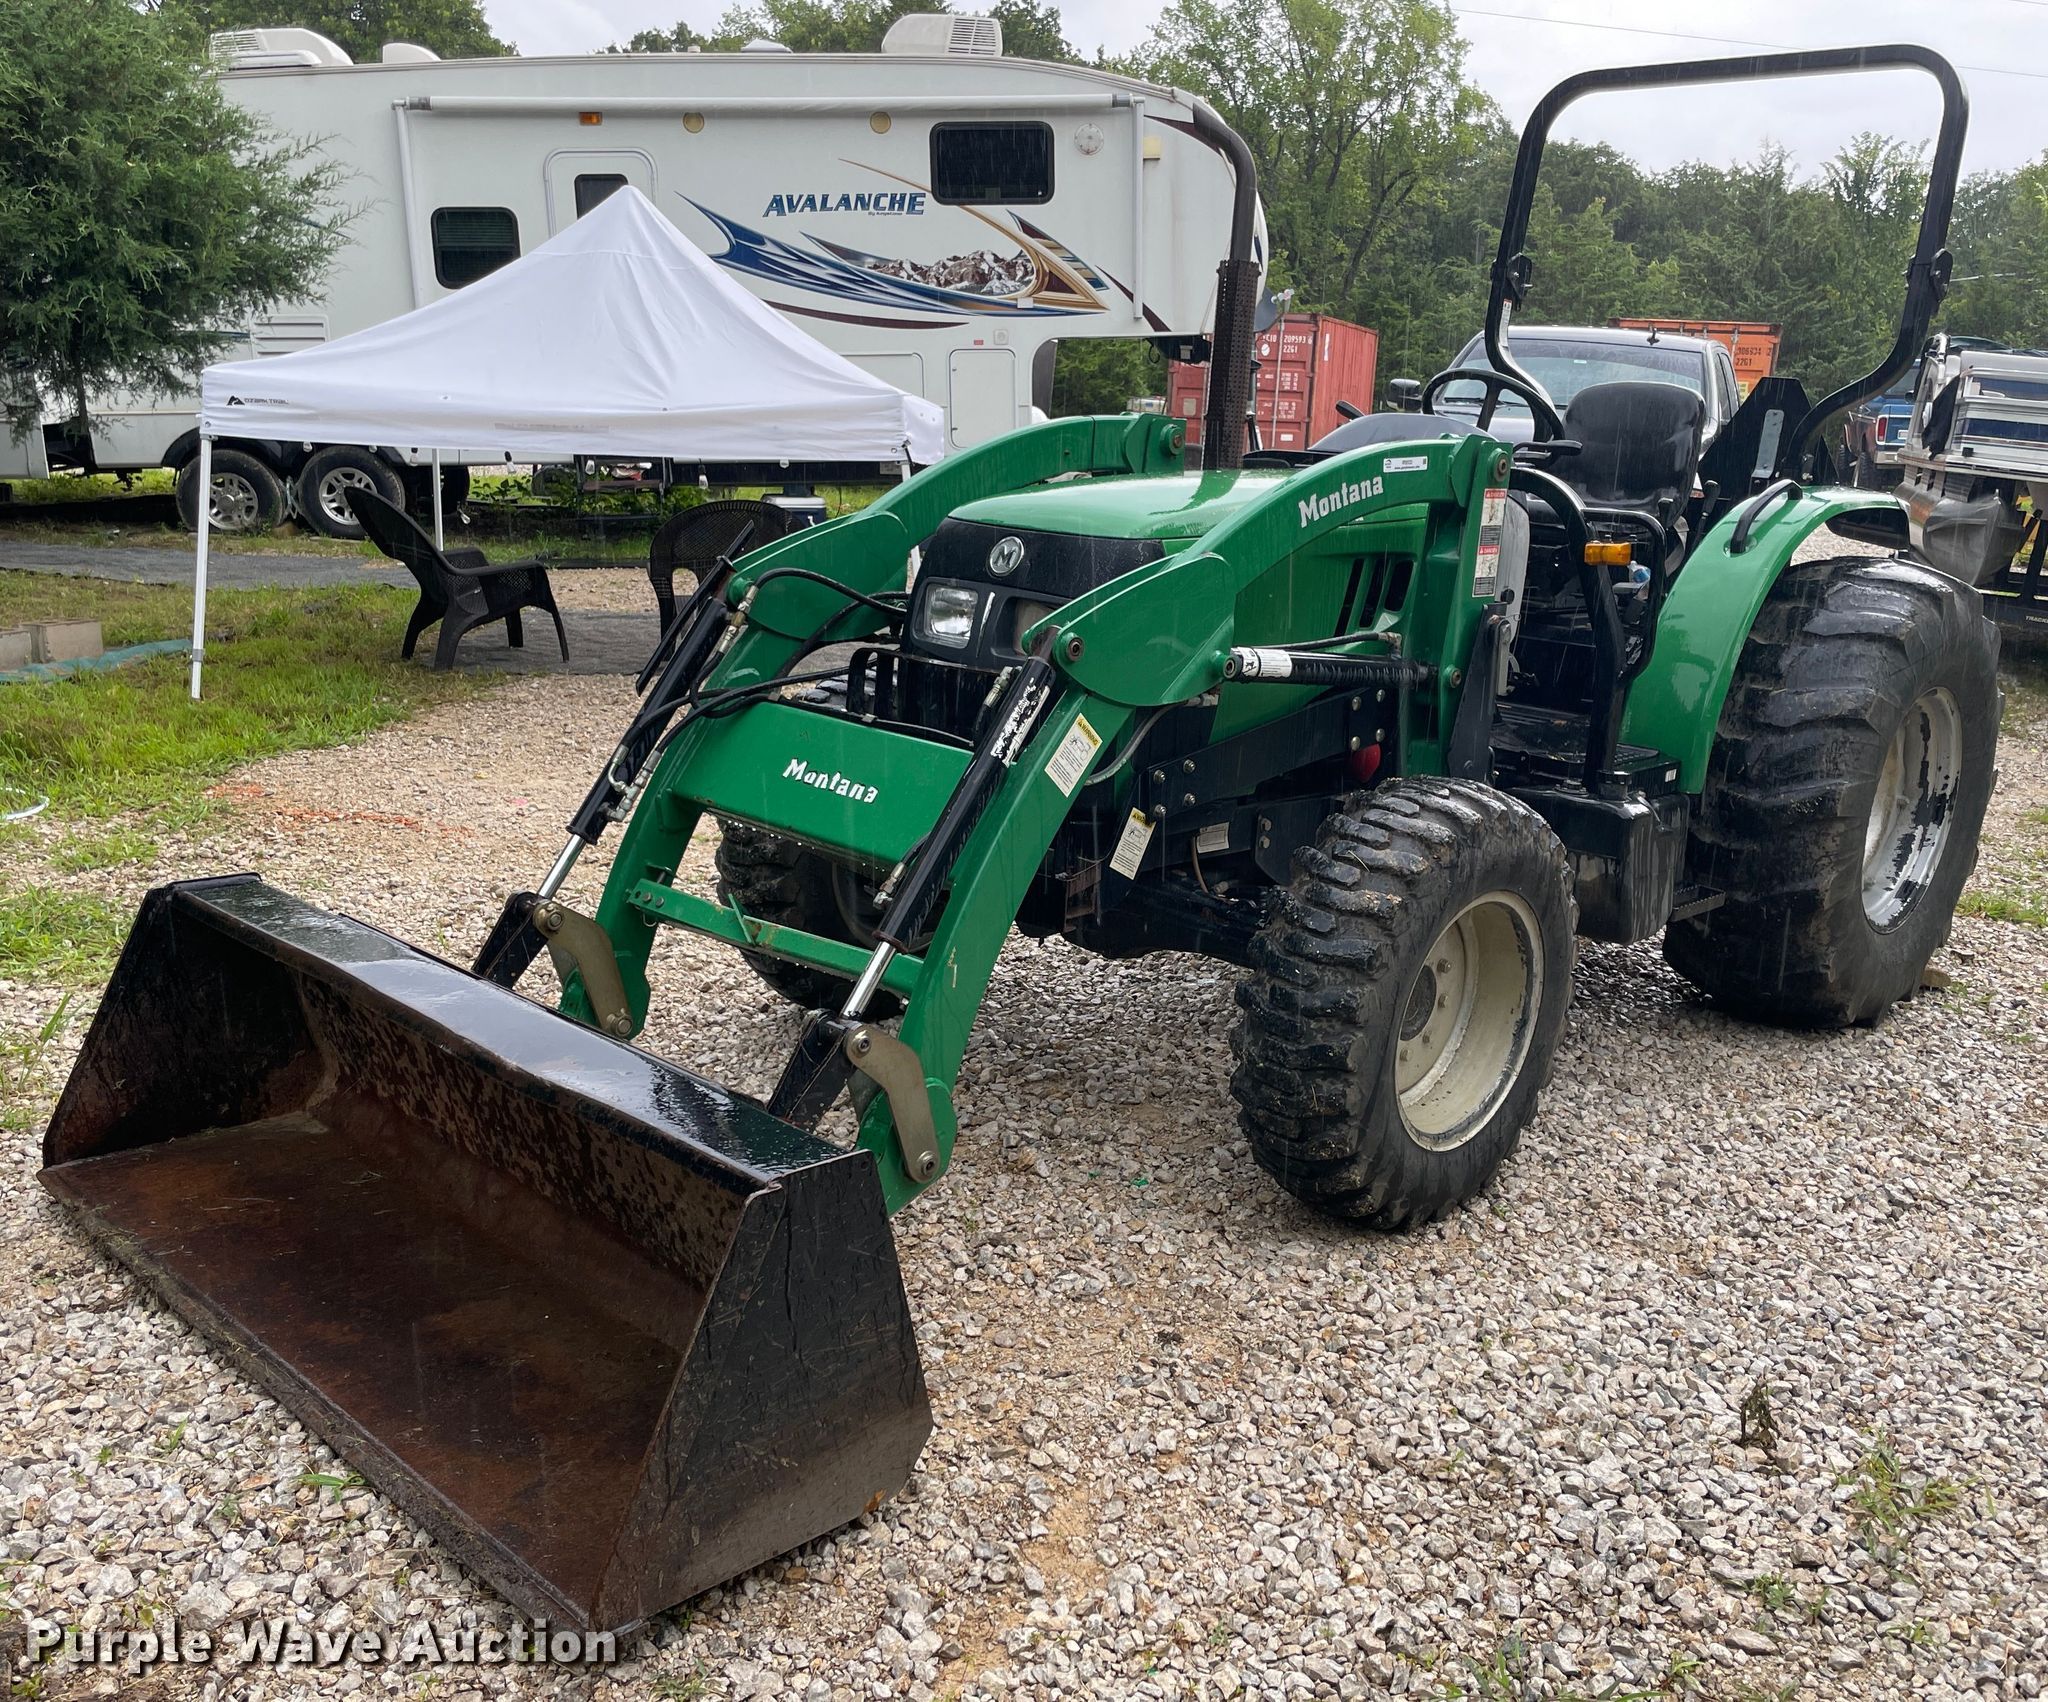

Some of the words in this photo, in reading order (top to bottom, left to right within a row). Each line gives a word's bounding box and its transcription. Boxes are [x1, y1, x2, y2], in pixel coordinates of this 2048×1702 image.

[762, 192, 927, 218] AVALANCHE
[1298, 476, 1384, 529] Montana
[782, 758, 879, 803] Montana
